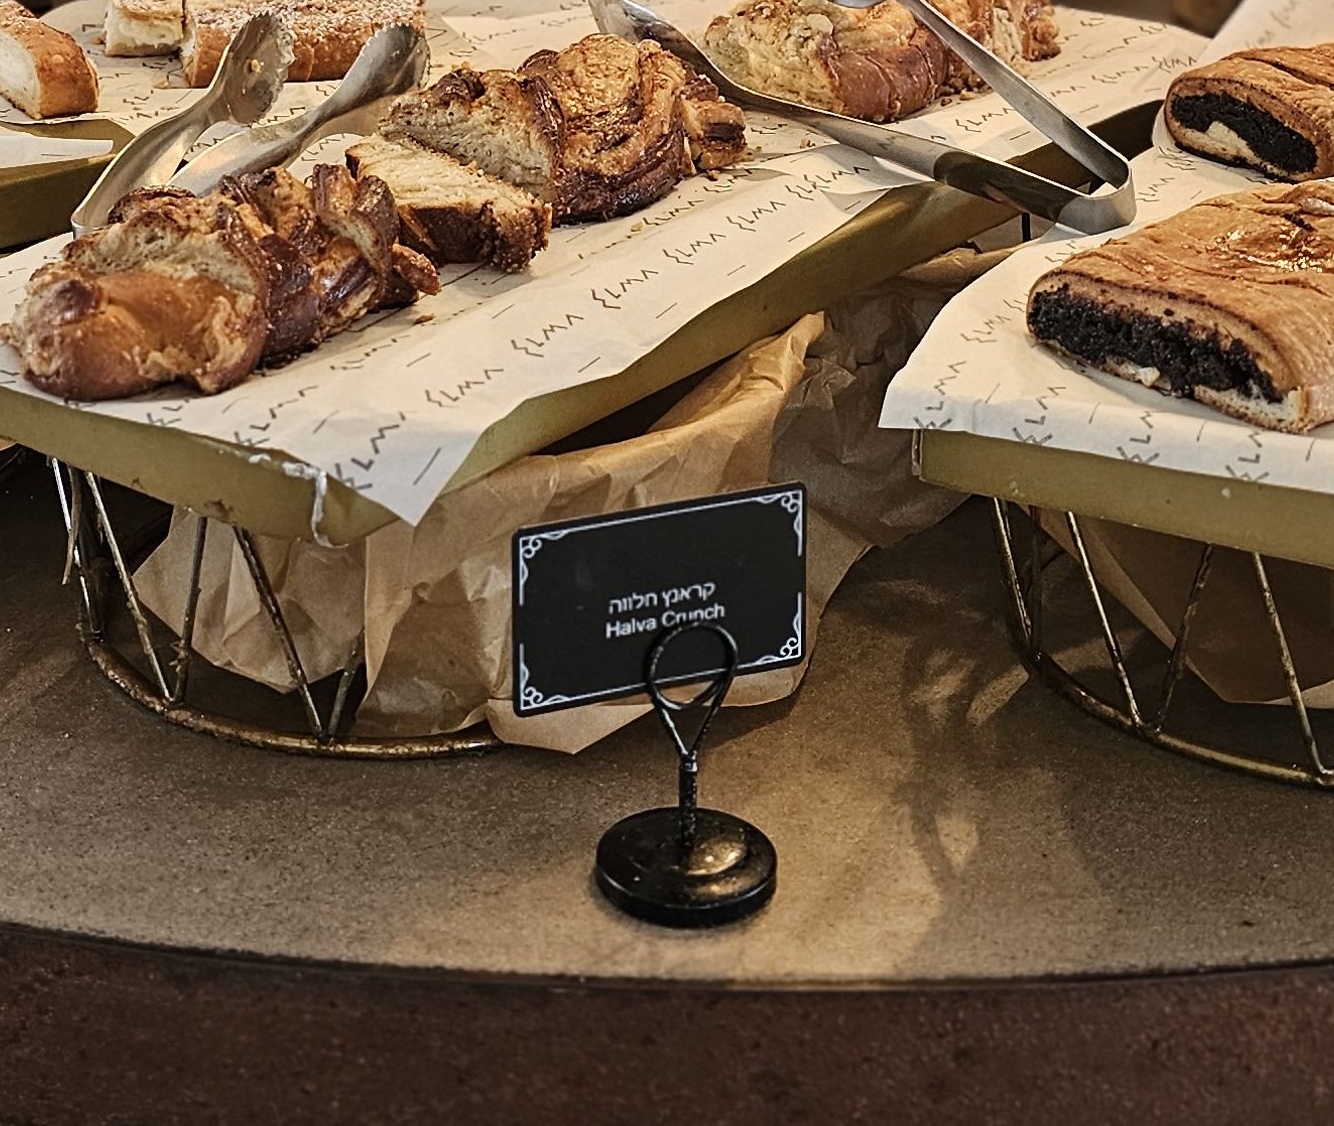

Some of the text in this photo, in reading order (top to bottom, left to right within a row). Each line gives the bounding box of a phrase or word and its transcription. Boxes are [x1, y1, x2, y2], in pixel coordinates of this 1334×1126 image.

[608, 581, 716, 614] קראנץ חלווה
[605, 617, 657, 639] Halva
